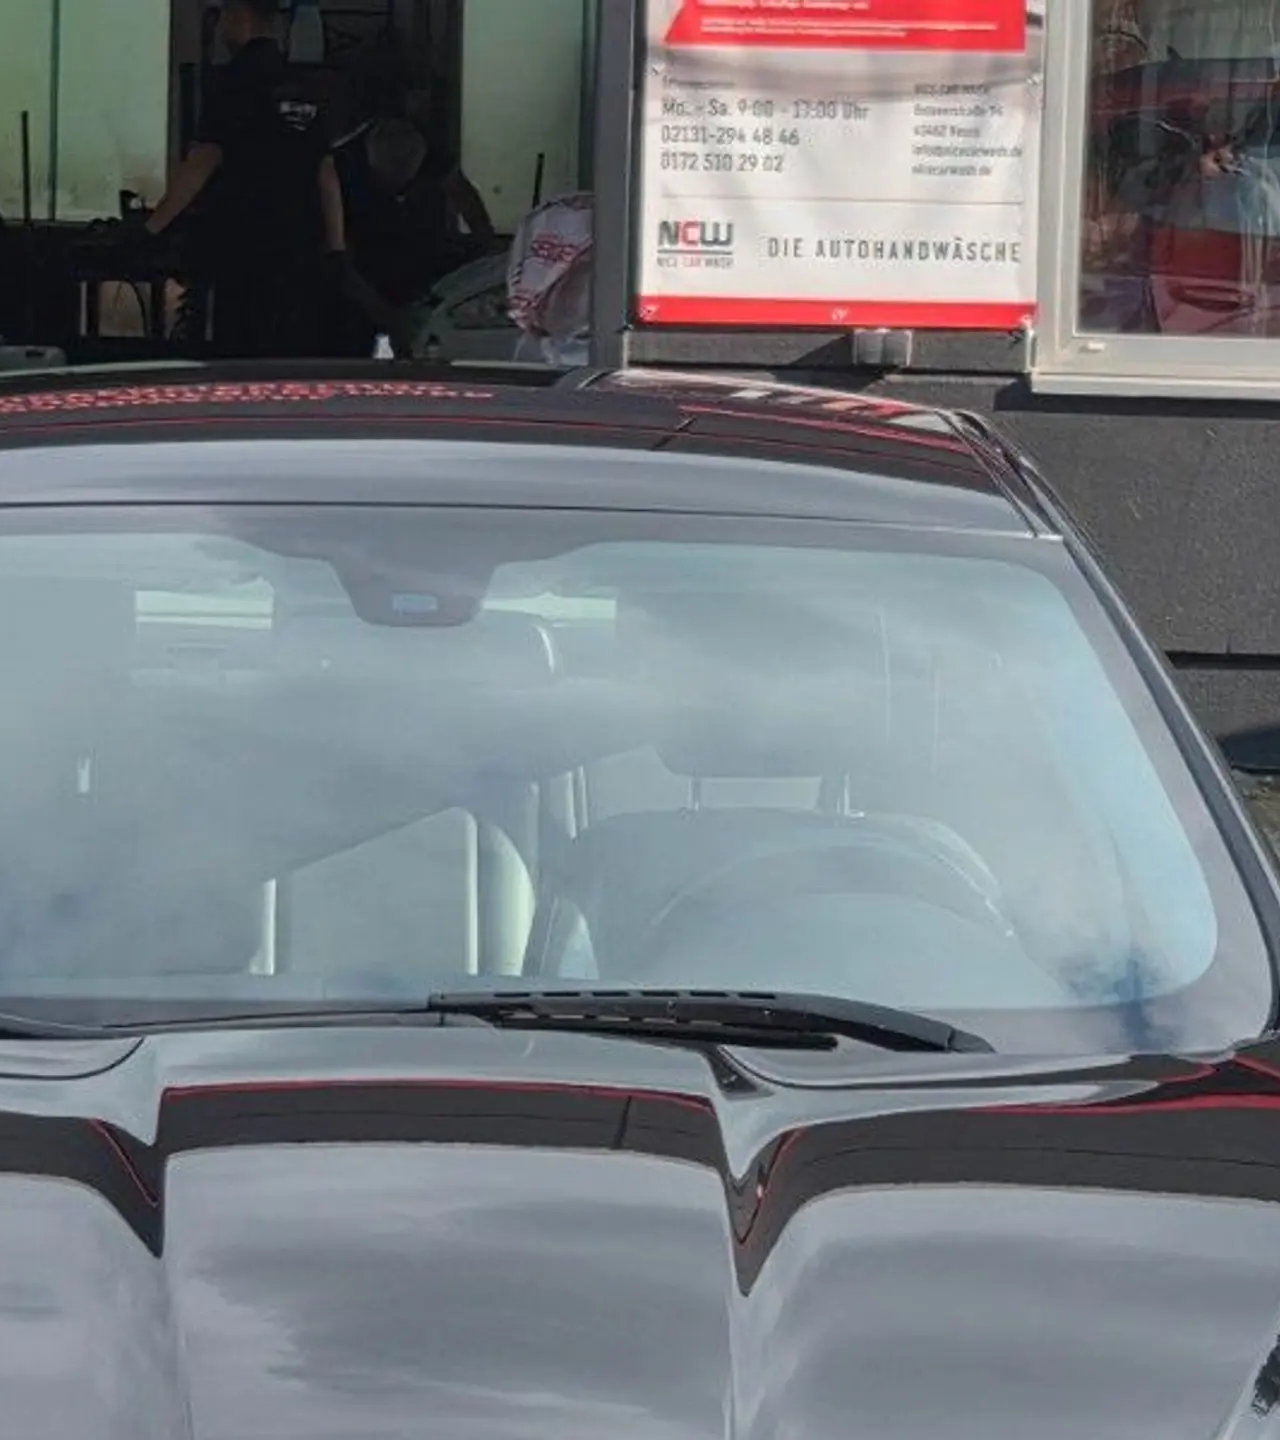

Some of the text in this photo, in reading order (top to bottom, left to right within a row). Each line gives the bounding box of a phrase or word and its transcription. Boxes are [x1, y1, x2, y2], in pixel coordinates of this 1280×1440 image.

[842, 101, 870, 120] Uhr
[753, 127, 773, 146] 48
[658, 220, 733, 246] NCW
[770, 236, 1022, 263] DIE AUTOHANDWÄSCHE
